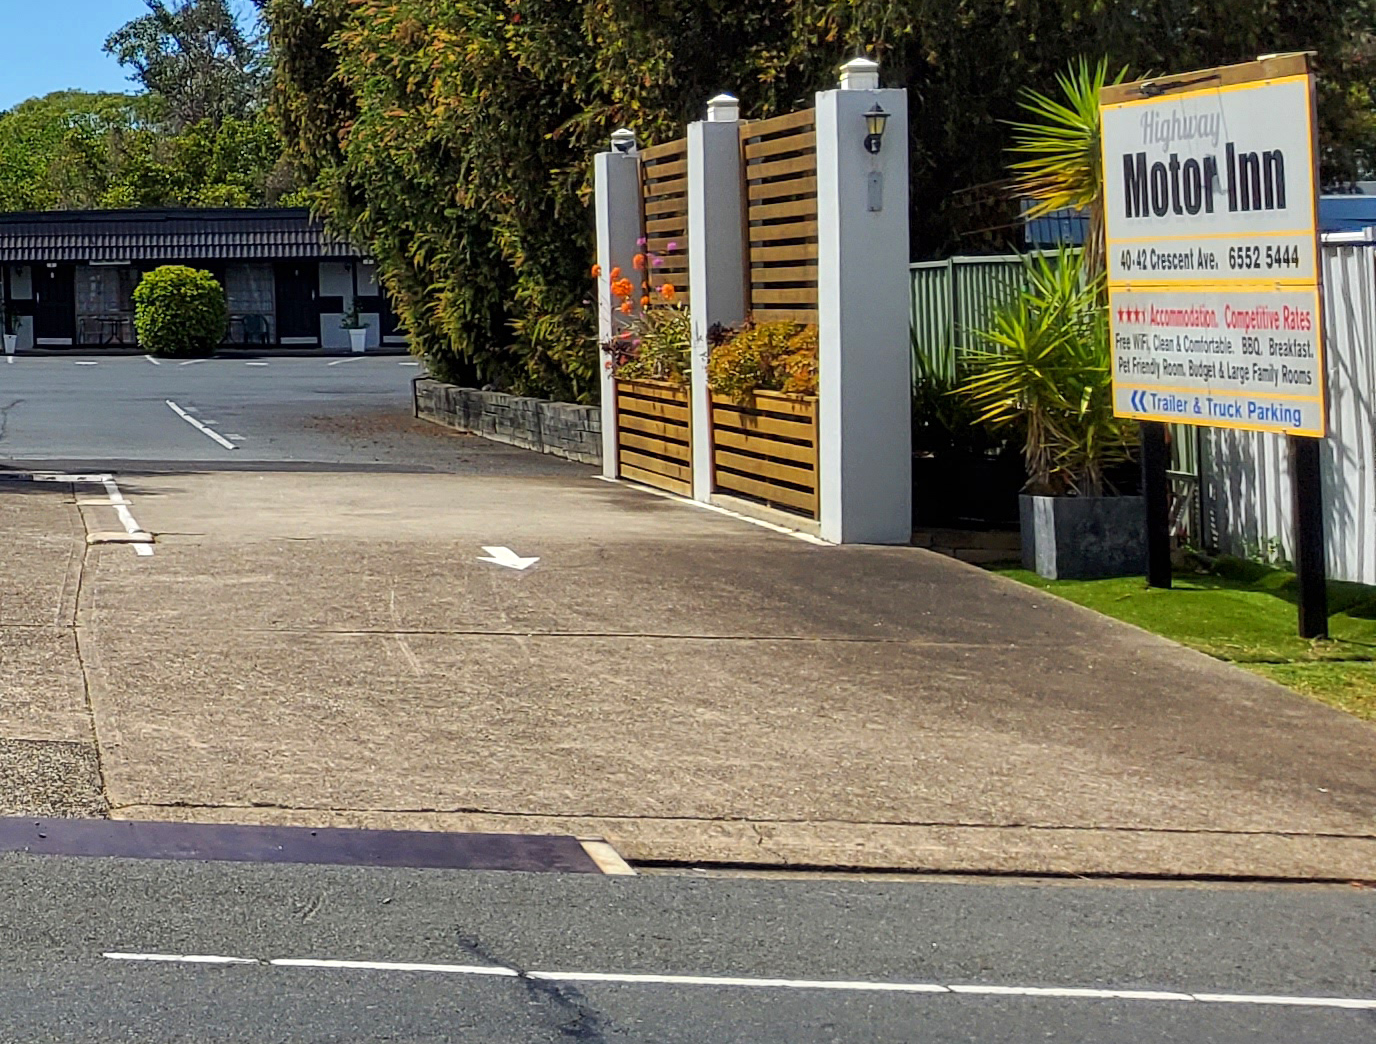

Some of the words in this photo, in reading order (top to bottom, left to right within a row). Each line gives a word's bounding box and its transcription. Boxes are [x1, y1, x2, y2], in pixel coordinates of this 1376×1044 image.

[1140, 109, 1221, 154] Highway
[1122, 151, 1218, 218] Motor
[1225, 141, 1287, 213] Inn
[1120, 248, 1147, 271] 40-42
[1150, 247, 1195, 271] Crescent
[1197, 247, 1219, 271] Ave.
[1228, 246, 1261, 270] 6552
[1265, 244, 1299, 269] 5444
[1224, 303, 1279, 336] Competitive
[1282, 305, 1312, 332] Rates
[1115, 332, 1131, 351] Free
[1153, 334, 1174, 353] Clean
[1176, 335, 1181, 352] &
[1183, 334, 1235, 355] Comfortable.
[1241, 336, 1263, 356] BBQ.
[1268, 337, 1314, 359] Breakfast.
[1118, 355, 1131, 374] Pet
[1132, 356, 1160, 379] Friendly
[1188, 359, 1216, 383] Budget
[1219, 360, 1225, 379] &
[1226, 361, 1250, 385] Large
[1252, 362, 1279, 387] Family
[1281, 364, 1312, 386] Rooms
[1150, 392, 1188, 414] Trailer
[1192, 396, 1202, 414] &
[1206, 397, 1243, 419] Truck
[1247, 401, 1302, 428] Parking
